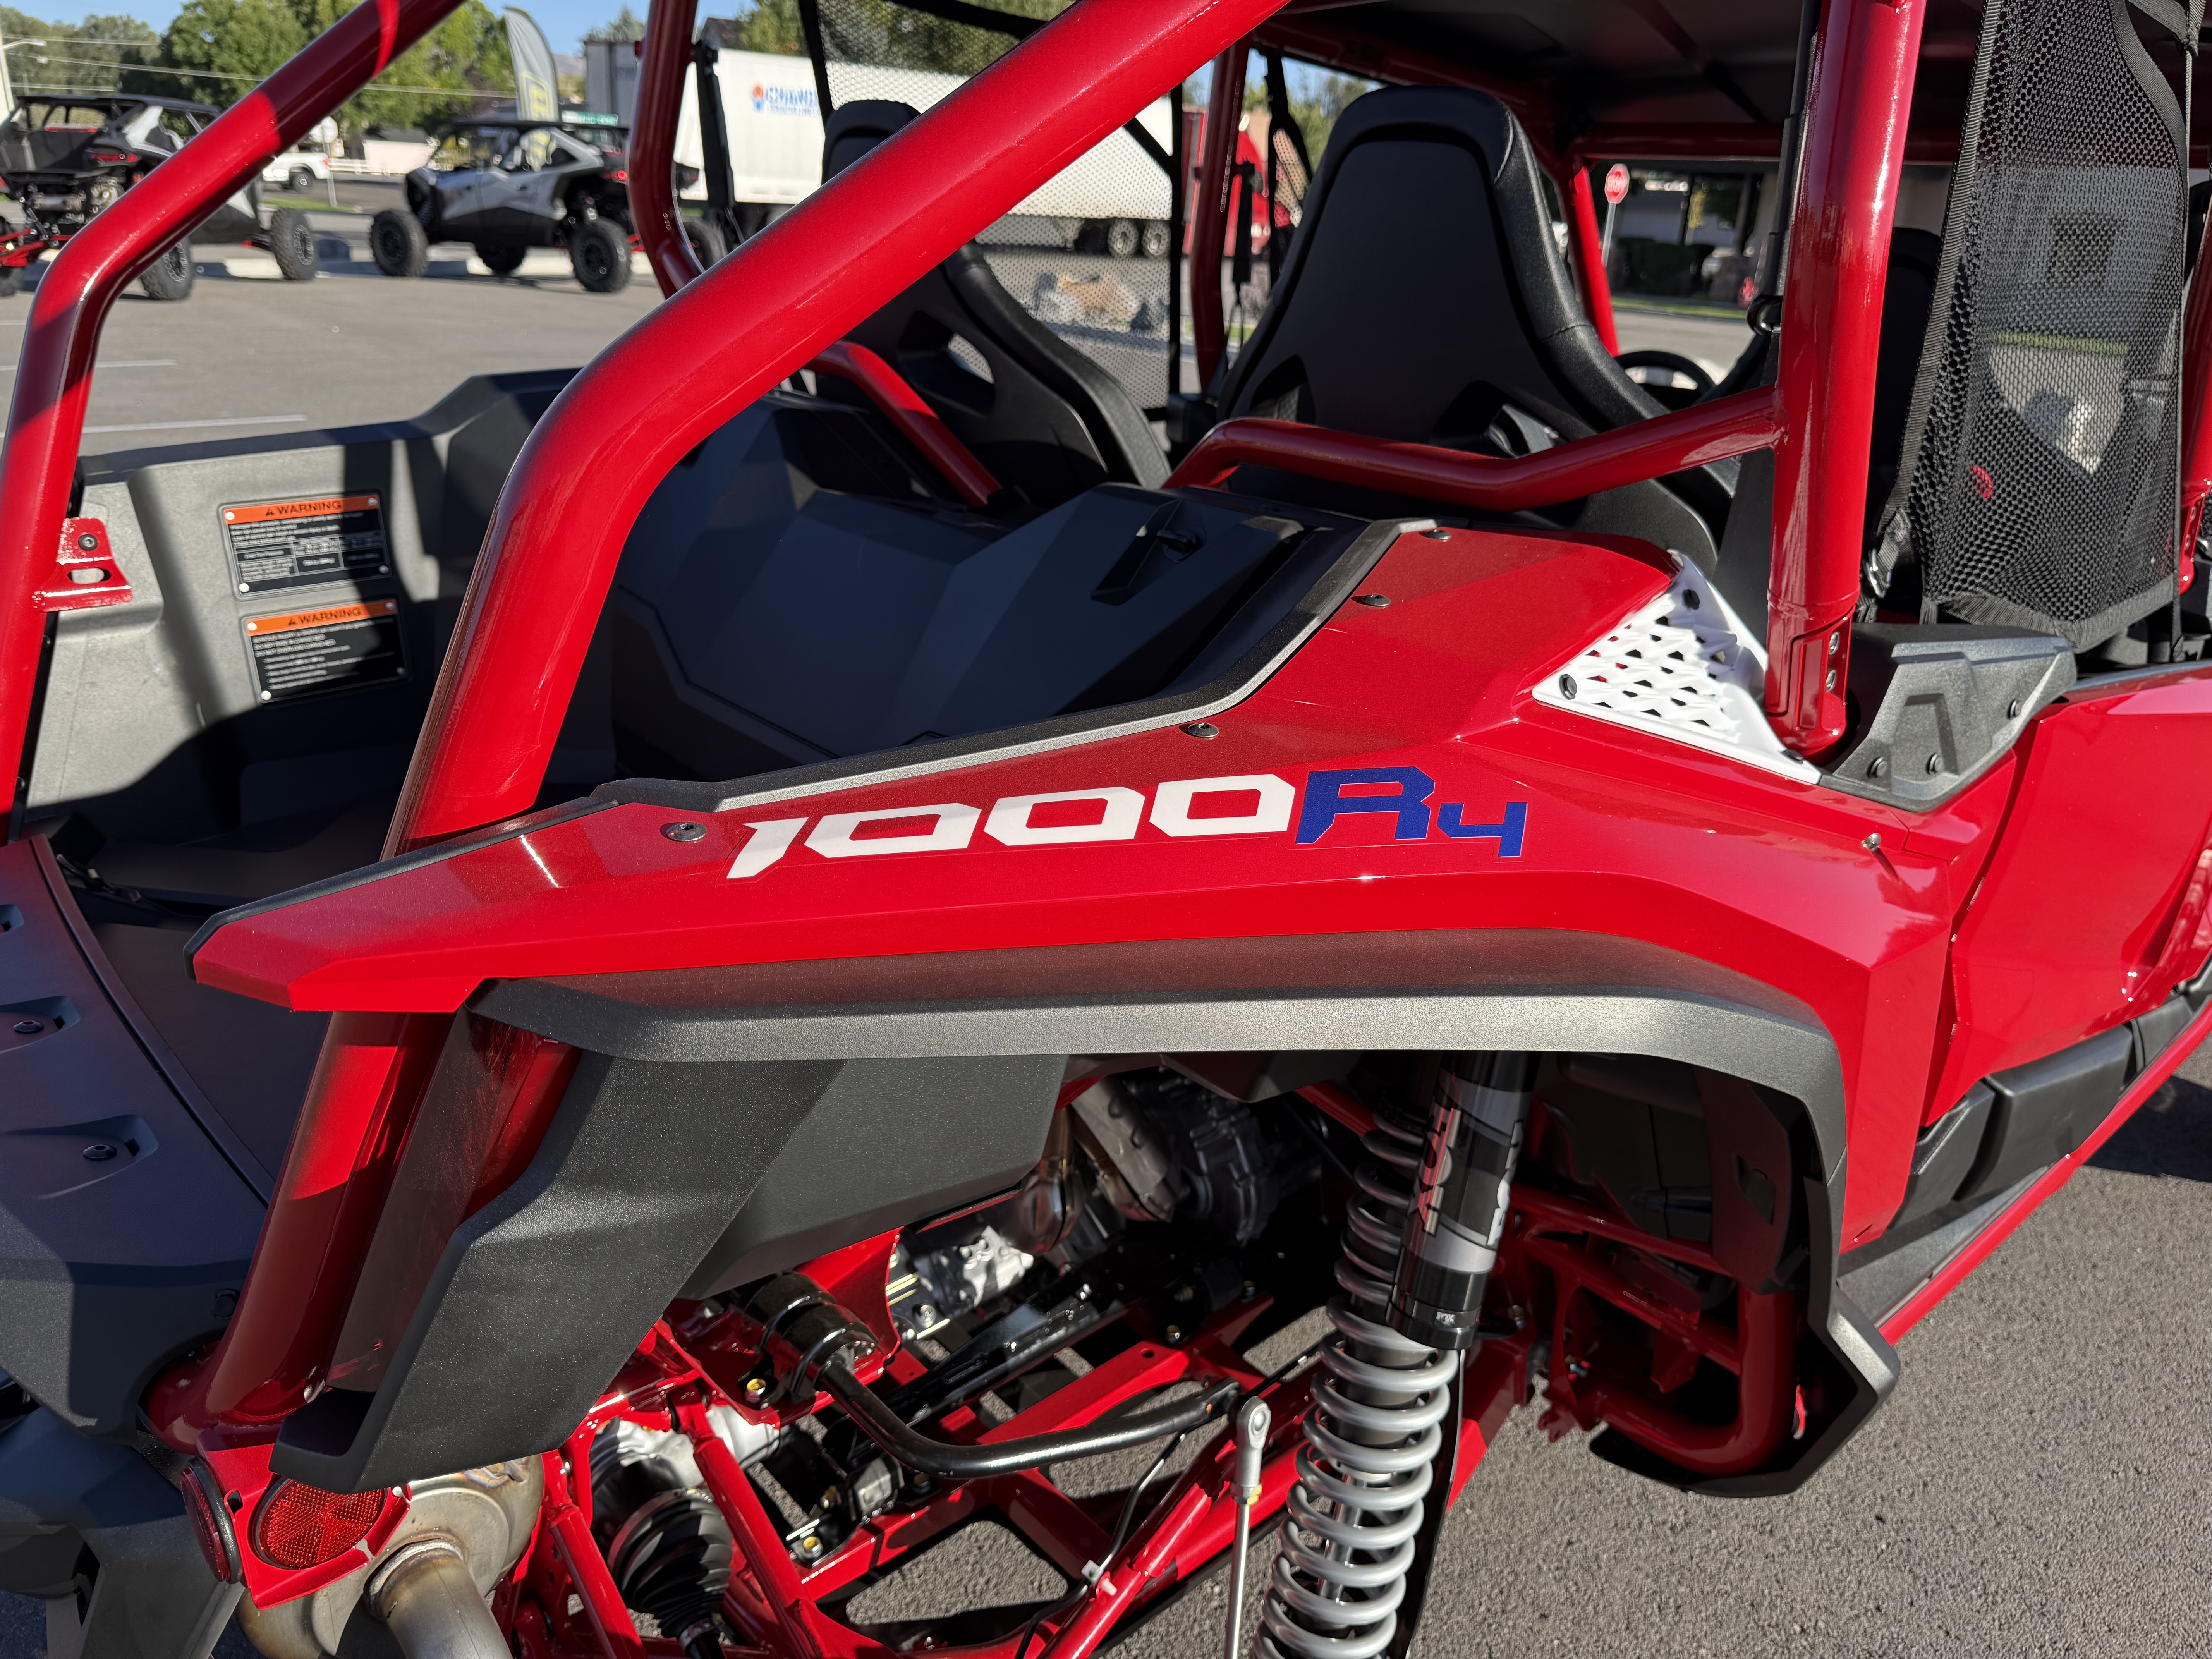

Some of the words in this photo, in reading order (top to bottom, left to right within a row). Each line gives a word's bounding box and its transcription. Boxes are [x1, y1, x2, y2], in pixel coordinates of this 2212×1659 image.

[1606, 175, 1628, 192] STOP
[277, 501, 341, 514] WARNING
[299, 607, 361, 623] WARNING
